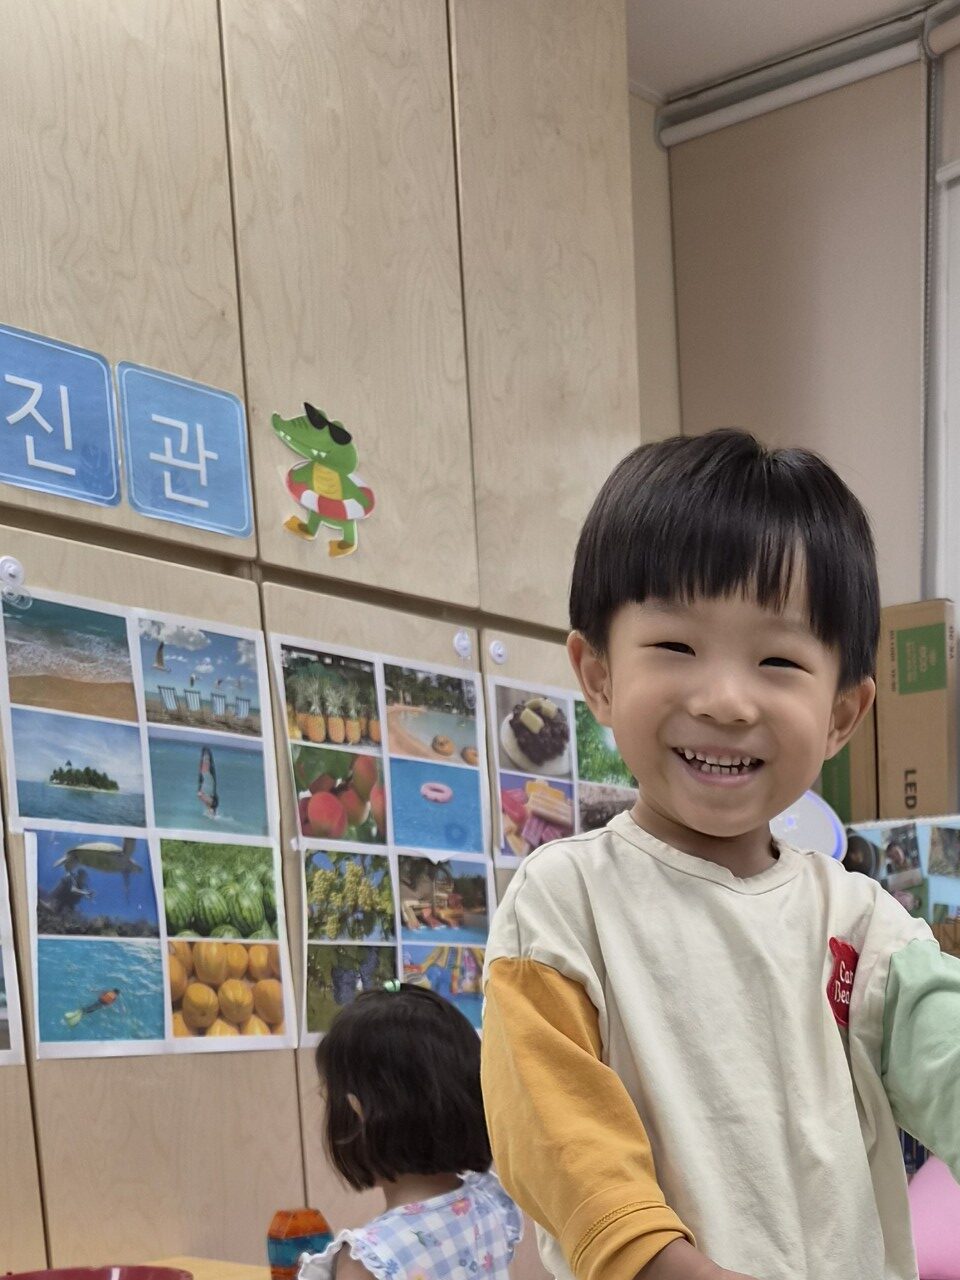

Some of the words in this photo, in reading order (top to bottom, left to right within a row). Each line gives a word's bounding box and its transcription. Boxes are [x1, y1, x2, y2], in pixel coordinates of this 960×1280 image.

[4, 374, 219, 508] 진관
[904, 769, 917, 810] LED
[840, 960, 854, 985] Car
[835, 979, 850, 1005] Bea
